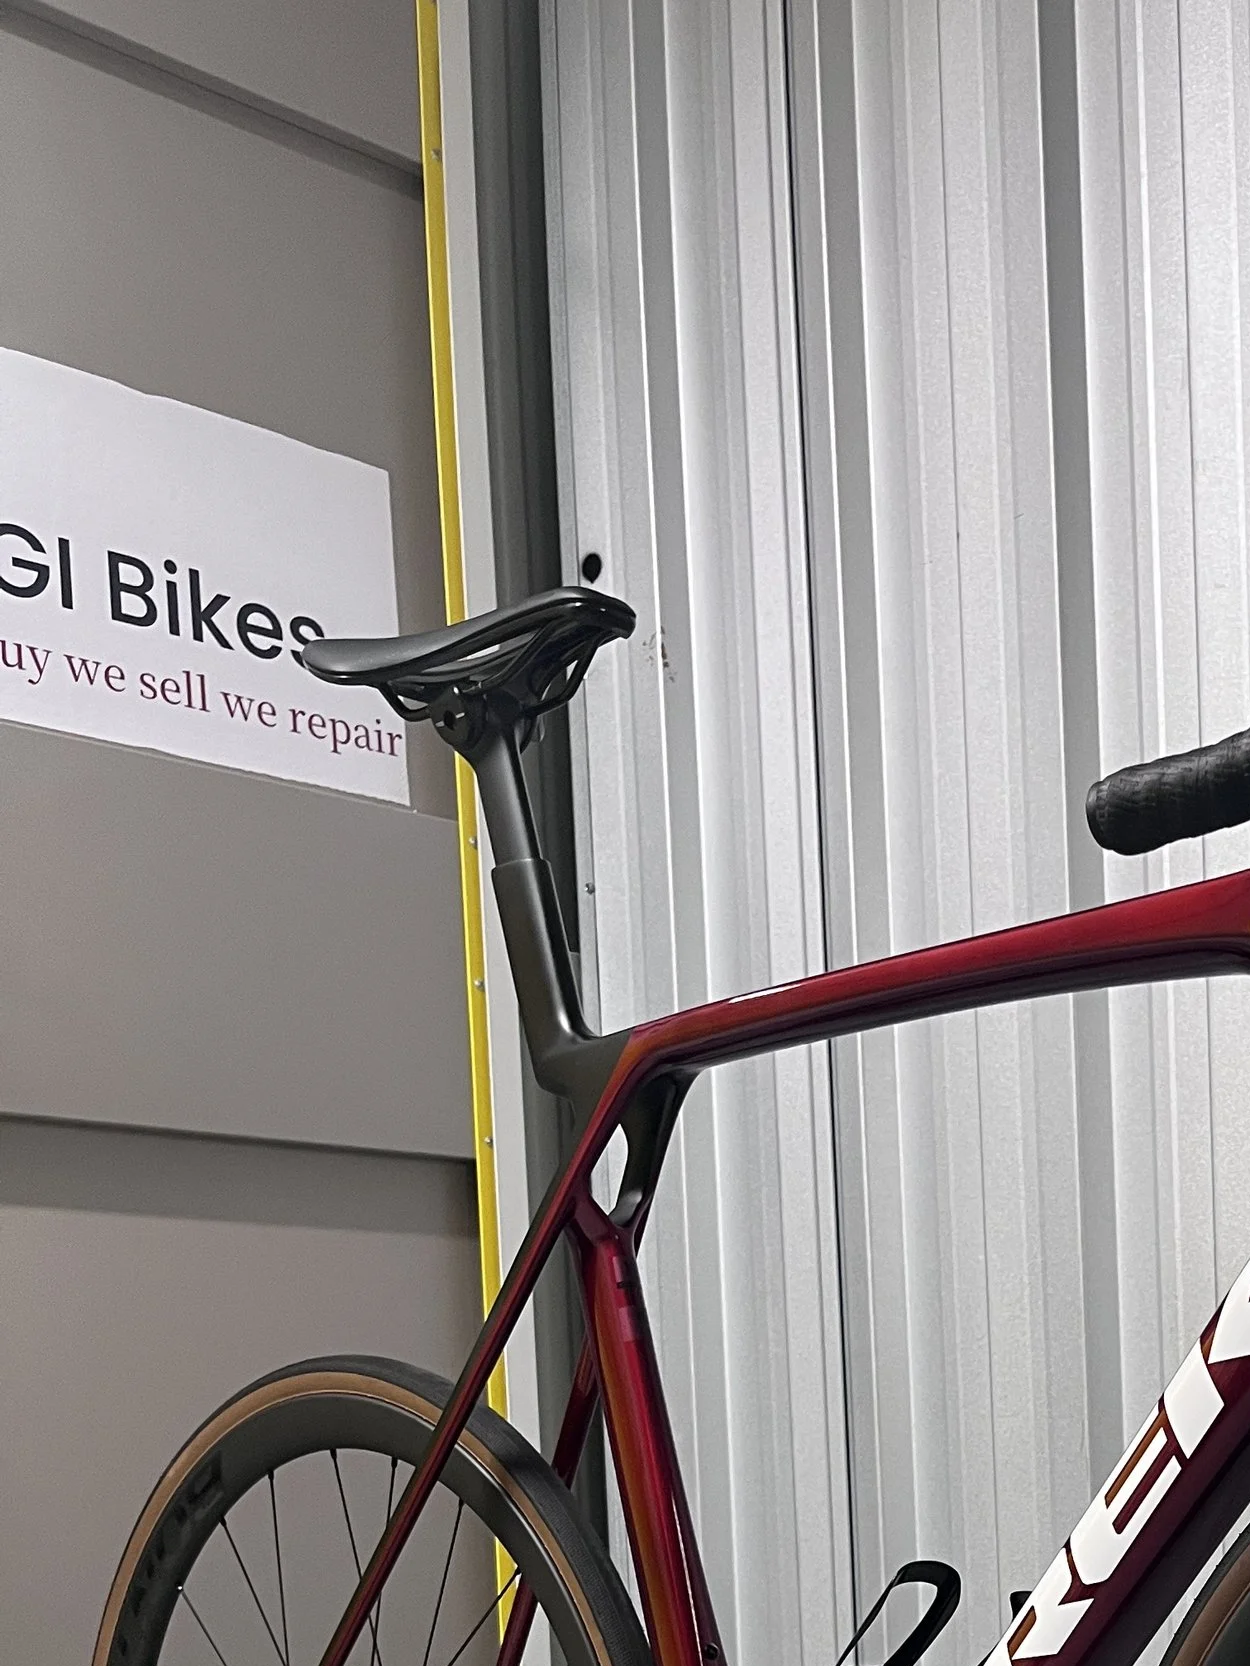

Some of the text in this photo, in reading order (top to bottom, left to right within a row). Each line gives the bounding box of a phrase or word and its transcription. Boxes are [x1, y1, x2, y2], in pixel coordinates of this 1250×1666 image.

[0, 523, 325, 669] GI Bikes
[0, 639, 403, 757] uy we sell we repair
